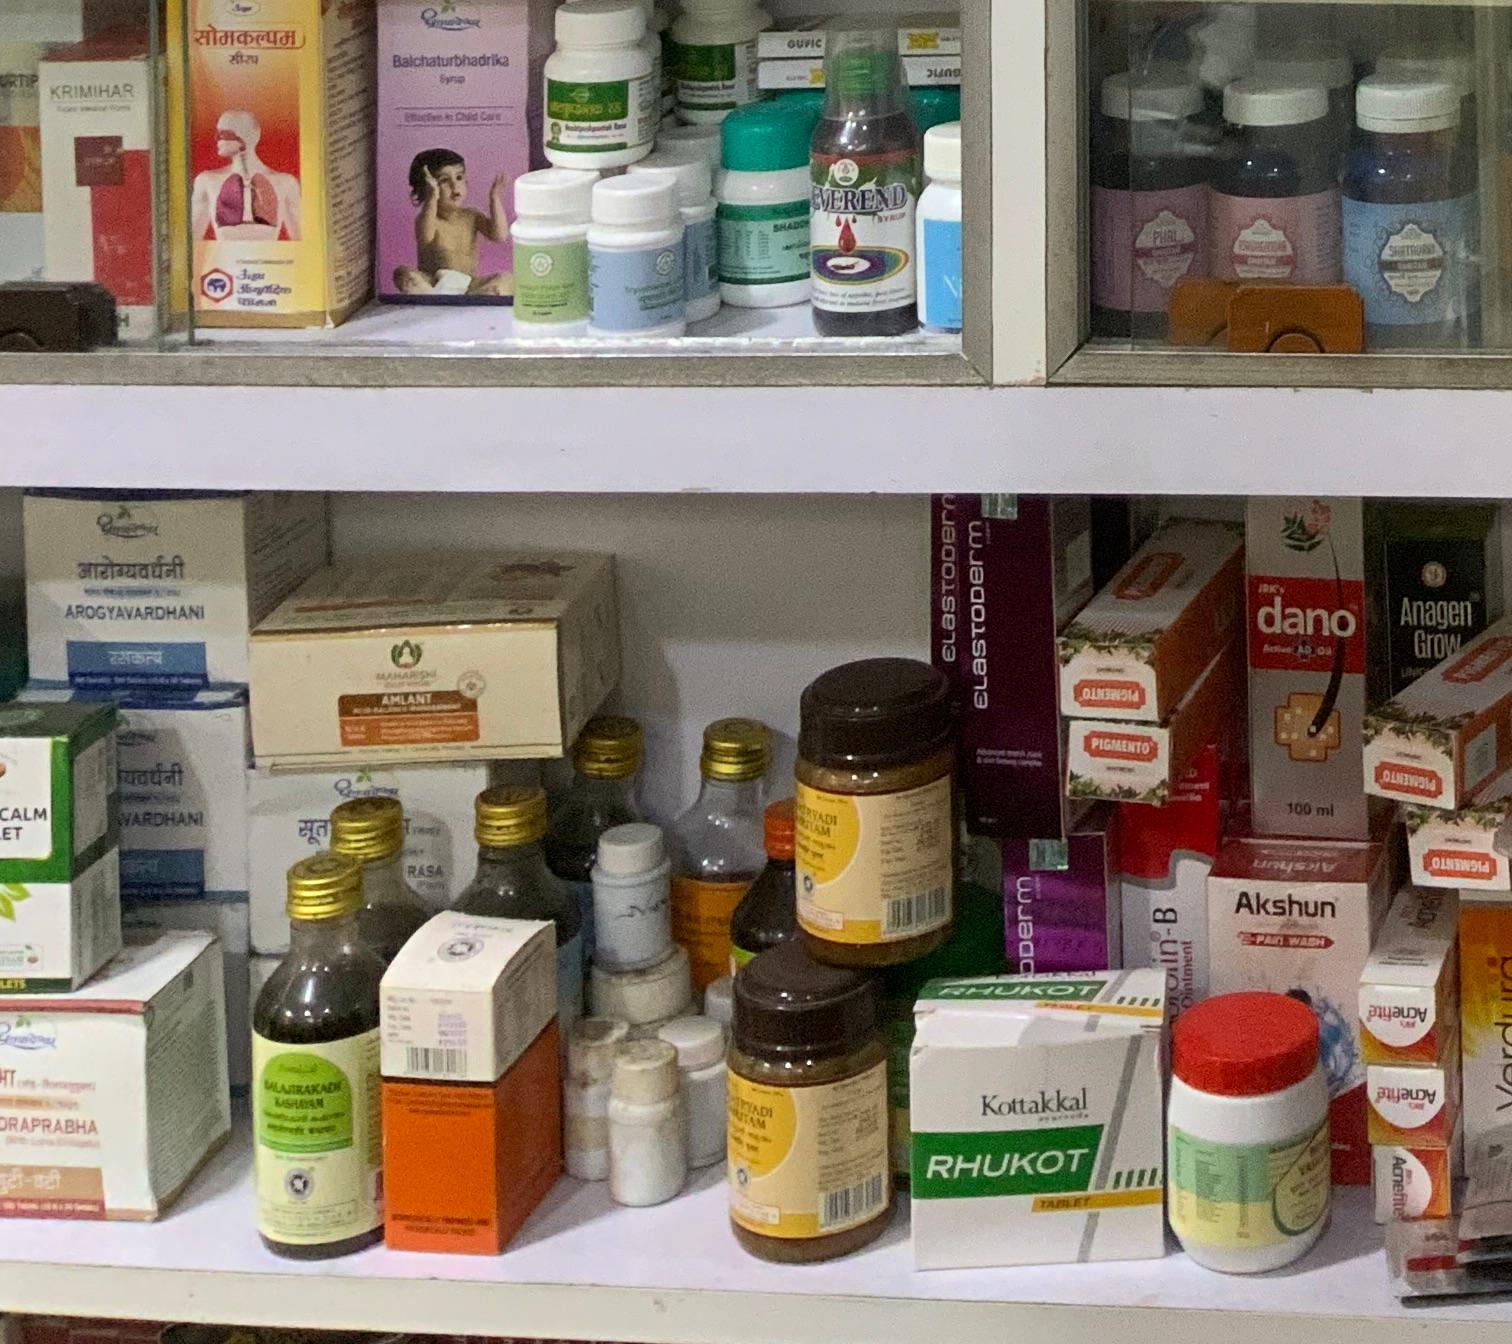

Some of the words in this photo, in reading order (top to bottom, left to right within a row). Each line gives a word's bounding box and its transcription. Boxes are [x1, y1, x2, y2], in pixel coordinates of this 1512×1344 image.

[194, 23, 298, 49] सोमकल्पम
[787, 38, 823, 51] GUFIC
[392, 52, 510, 70] Balchaturbhadrika
[439, 74, 466, 86] Syrup
[50, 82, 135, 100] KRIMIHAR
[77, 556, 185, 582] आरोग्यवर्धनी
[64, 604, 205, 622] AROGYAVARDHANI
[1256, 596, 1356, 638] dano
[1400, 595, 1472, 628] Anagen
[1263, 643, 1294, 656] Active
[1413, 629, 1462, 660] Grow
[381, 693, 432, 706] AMLANT
[1082, 687, 1138, 704] PIGMENTO
[1091, 736, 1150, 754] PIGMENTO
[1381, 769, 1438, 792] PIGMENTO
[1286, 800, 1313, 818] 100
[1316, 800, 1334, 817] ml
[407, 863, 444, 879] RASA
[1431, 855, 1490, 874] PIGMENTO
[1234, 890, 1337, 919] Akshun
[1256, 934, 1286, 946] PAIN
[1289, 934, 1328, 948] WASH
[938, 980, 1101, 1002] RHUKOT
[1366, 1002, 1428, 1024] Acnefite
[981, 1087, 1089, 1119] Kottakkal
[1374, 1084, 1437, 1106] Acnefite
[926, 1148, 1090, 1180] RHUKOT
[1039, 1197, 1092, 1210] TABLET
